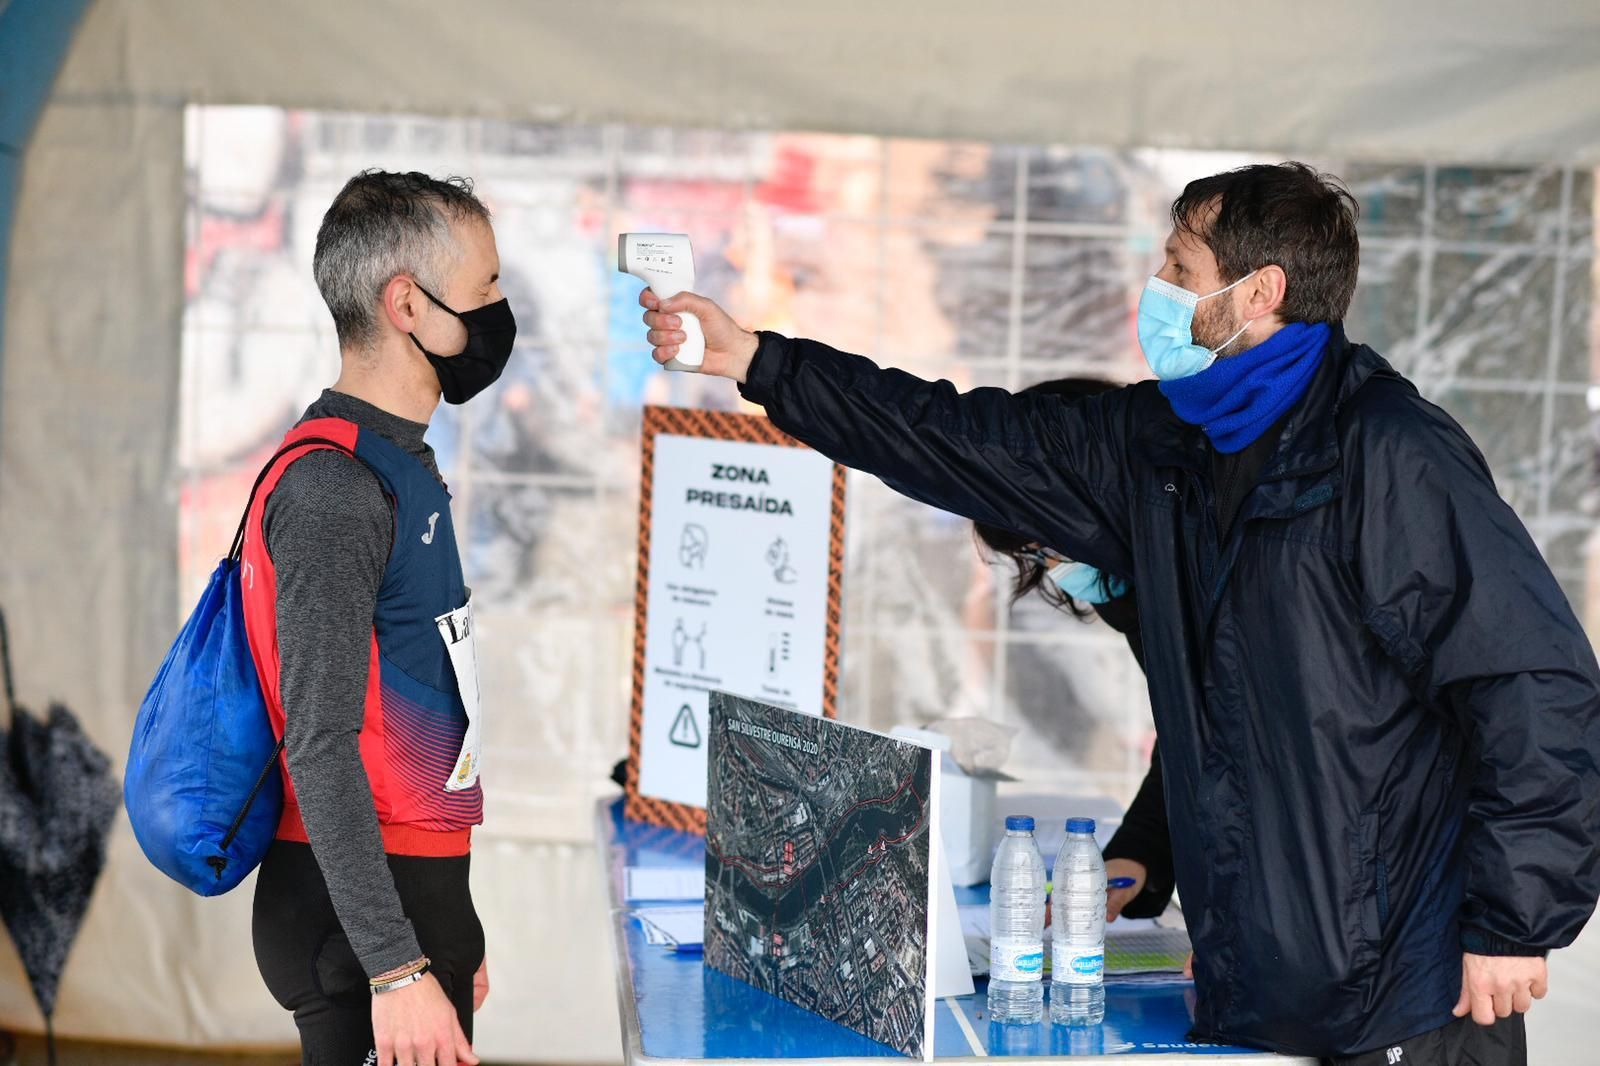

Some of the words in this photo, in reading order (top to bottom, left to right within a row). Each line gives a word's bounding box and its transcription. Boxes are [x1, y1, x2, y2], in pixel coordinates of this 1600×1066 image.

[711, 463, 770, 485] ZONA
[686, 488, 793, 516] PRESAÍDA
[728, 718, 740, 732] SAN
[741, 722, 771, 741] SILVESTRE
[802, 740, 818, 755] 2020
